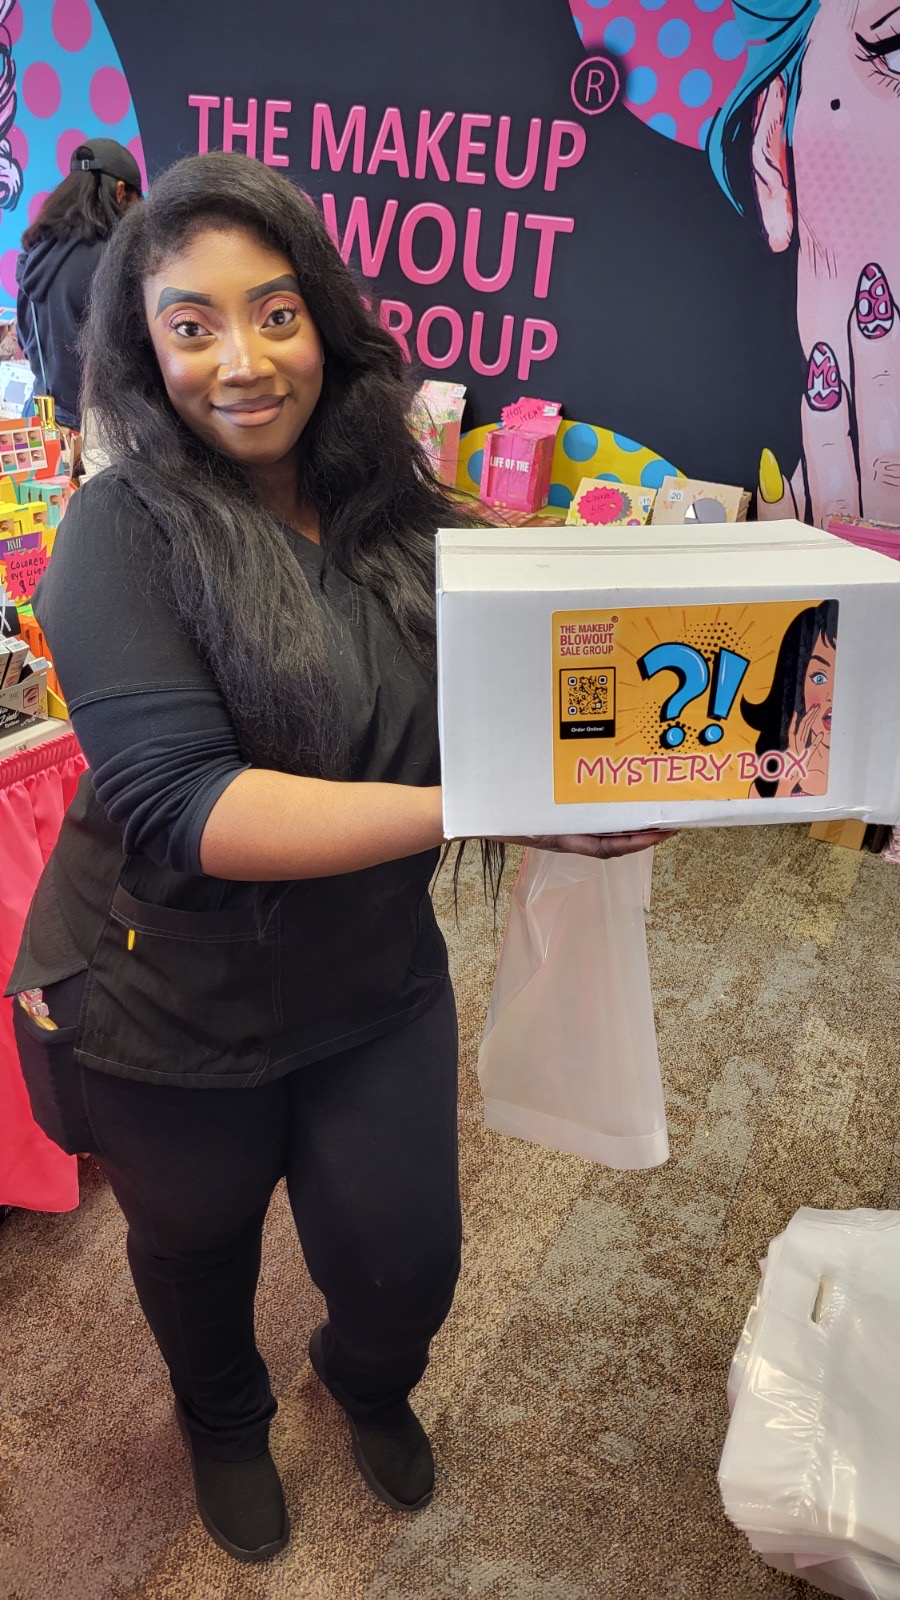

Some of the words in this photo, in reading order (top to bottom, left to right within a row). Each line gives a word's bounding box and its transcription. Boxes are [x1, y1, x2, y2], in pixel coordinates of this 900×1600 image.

[188, 95, 292, 167] THE
[310, 103, 587, 192] MAKEUP
[361, 295, 559, 381] ROUP
[506, 405, 523, 420] HOT
[490, 456, 504, 468] LIFE
[505, 459, 515, 469] OF
[516, 460, 530, 473] THE
[11, 557, 44, 570] COLORED
[11, 571, 23, 580] EYE
[560, 625, 576, 634] THE
[578, 623, 614, 633] MAKEUP
[560, 633, 614, 646] BLOWOUT
[560, 646, 581, 656] SALE
[582, 645, 614, 655] GROUP
[577, 753, 732, 785] MYSTERY
[736, 749, 809, 781] BOX
